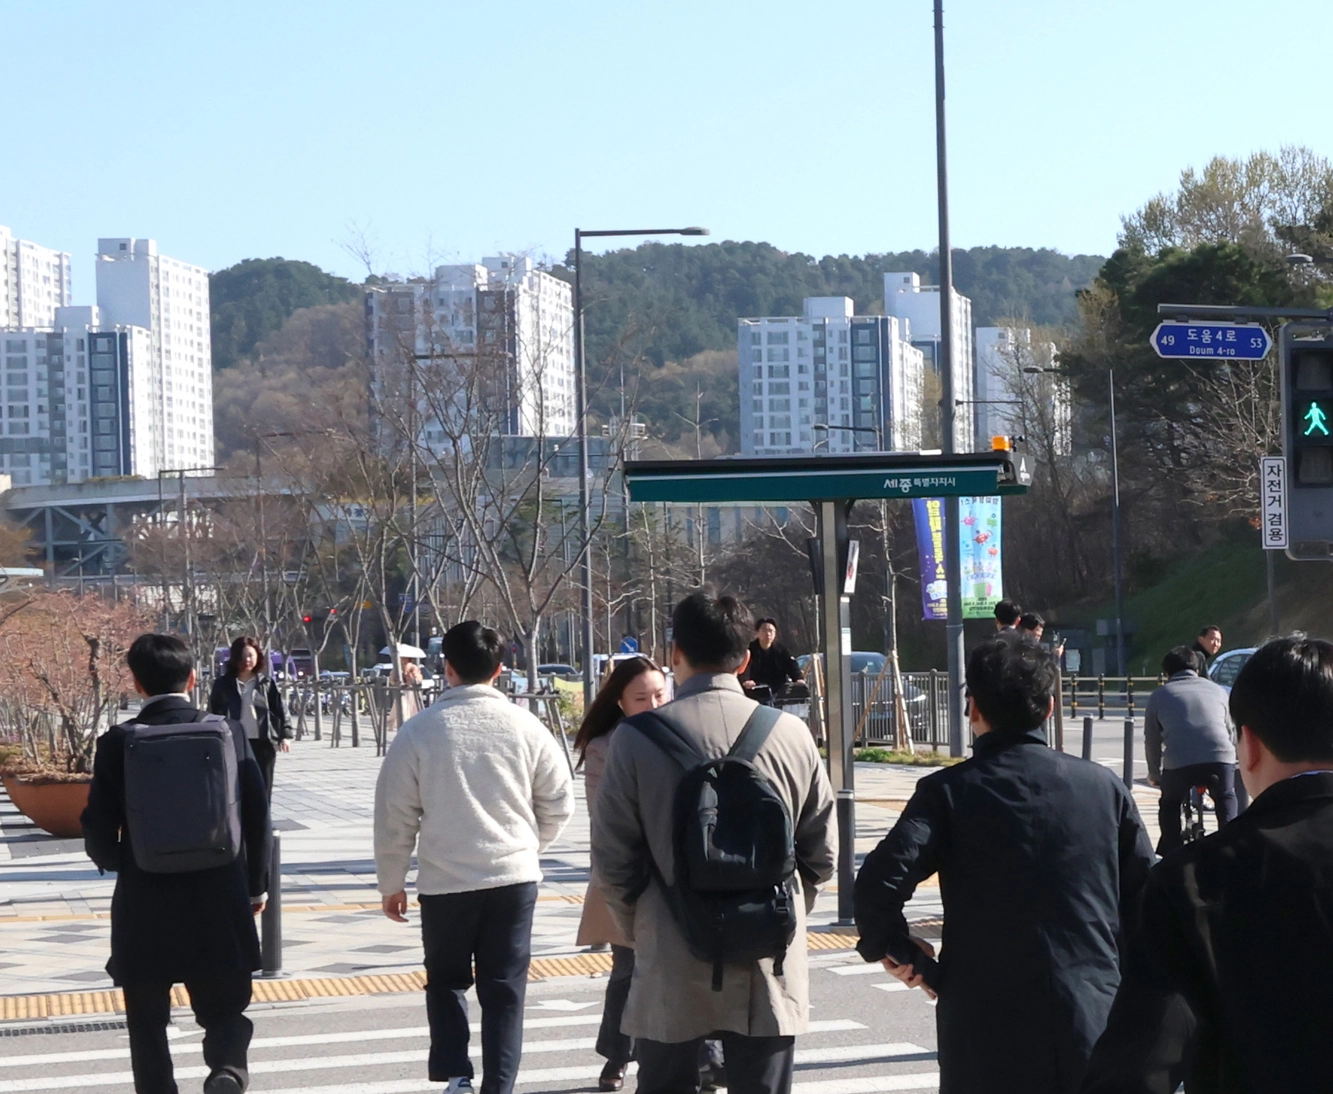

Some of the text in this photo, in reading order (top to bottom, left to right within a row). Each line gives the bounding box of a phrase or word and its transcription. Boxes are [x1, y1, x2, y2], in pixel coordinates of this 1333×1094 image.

[1160, 335, 1175, 346] 49
[1187, 329, 1237, 344] 도움4로
[1250, 338, 1263, 348] 53
[1189, 345, 1236, 356] Doum 4-ro
[1267, 464, 1284, 542] 자전거 겸용
